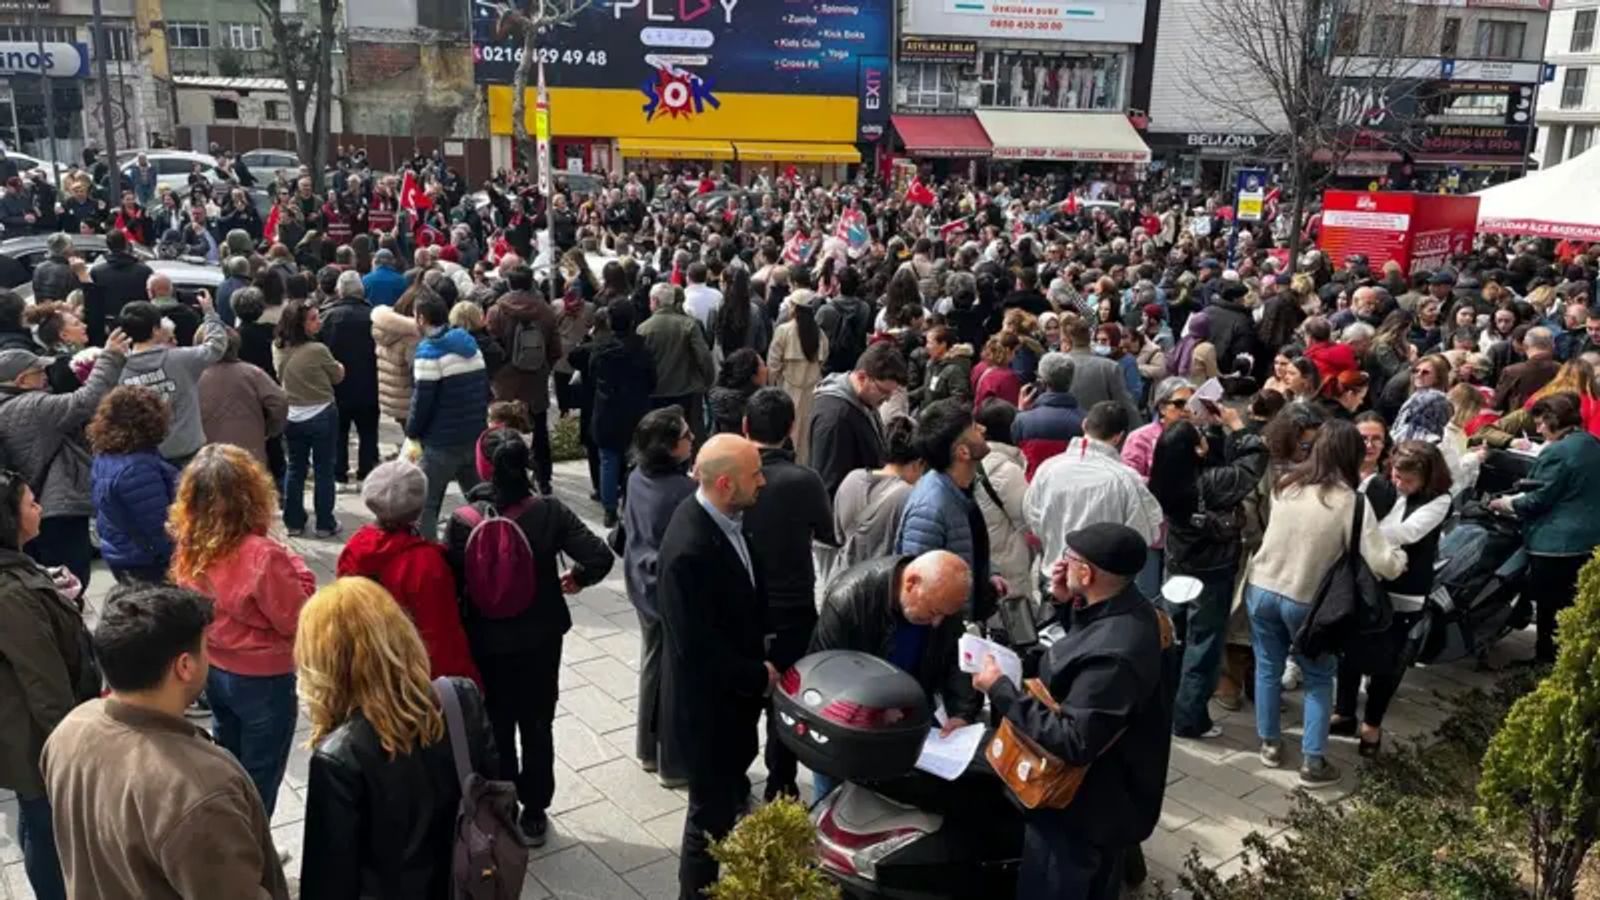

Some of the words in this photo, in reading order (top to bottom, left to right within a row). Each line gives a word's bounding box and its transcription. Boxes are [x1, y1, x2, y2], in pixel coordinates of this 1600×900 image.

[821, 4, 859, 15] Spinning
[788, 14, 817, 23] Zumba
[823, 30, 841, 39] Kick
[844, 30, 865, 40] Boks
[780, 39, 799, 48] Kids
[801, 39, 821, 49] Club
[482, 46, 522, 62] 0216
[562, 49, 583, 65] 49
[586, 50, 607, 66] 48
[827, 49, 849, 60] Yoga
[781, 58, 805, 68] Cross
[866, 67, 880, 109] EXIT
[1187, 133, 1258, 148] BELLONA
